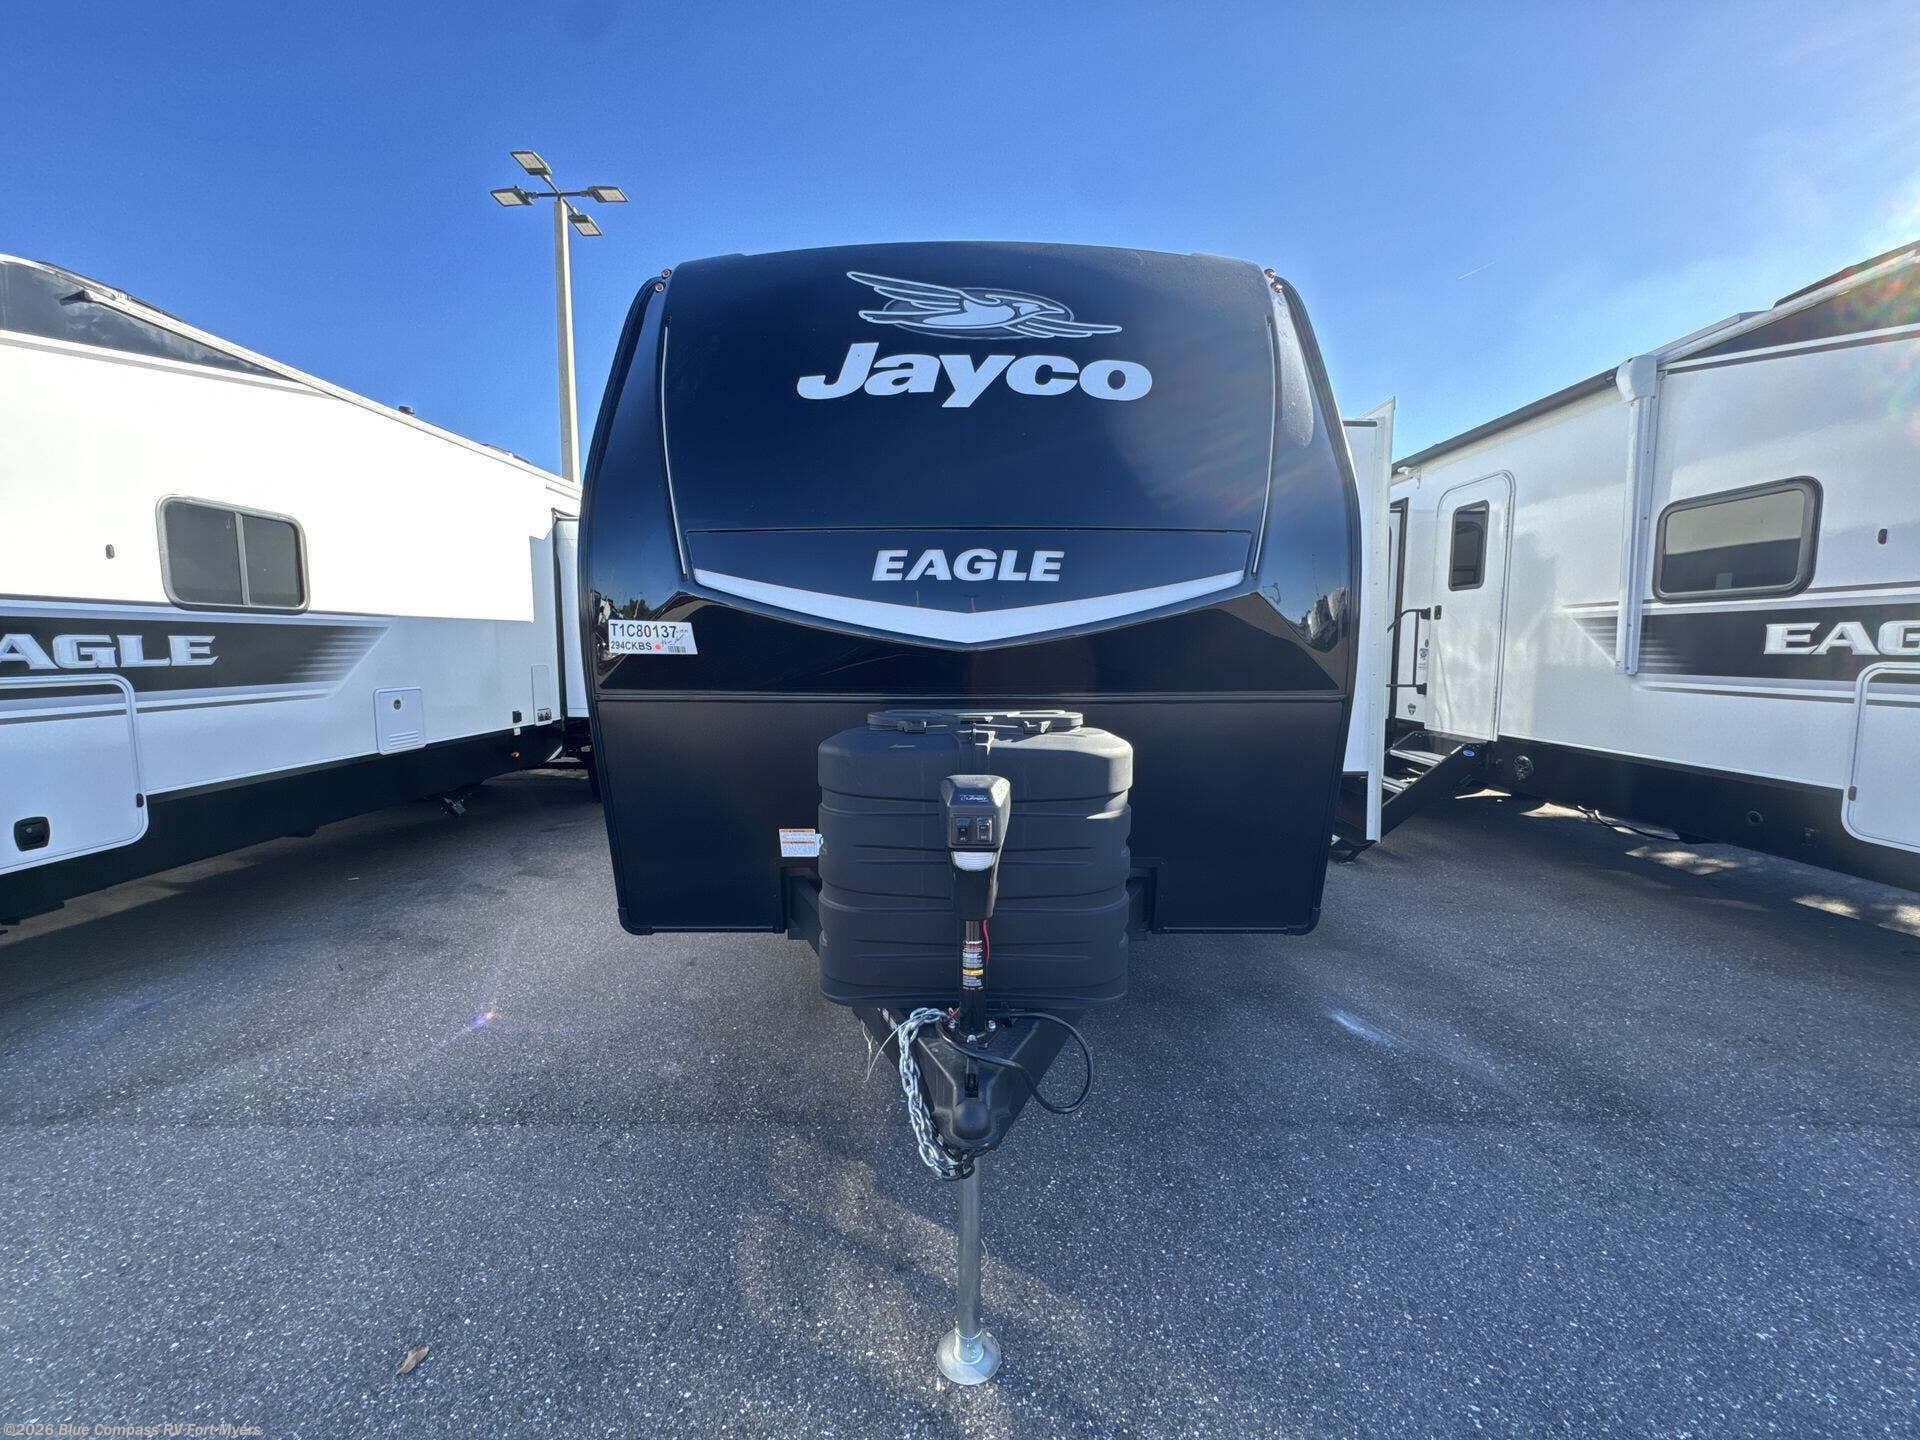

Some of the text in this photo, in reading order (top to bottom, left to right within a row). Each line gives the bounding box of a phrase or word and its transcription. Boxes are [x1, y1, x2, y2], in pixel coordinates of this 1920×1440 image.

[797, 342, 1153, 408] Jayco
[872, 548, 1065, 582] EAGLE
[610, 623, 677, 639] T1C80137
[610, 640, 653, 651] 294CKBS
